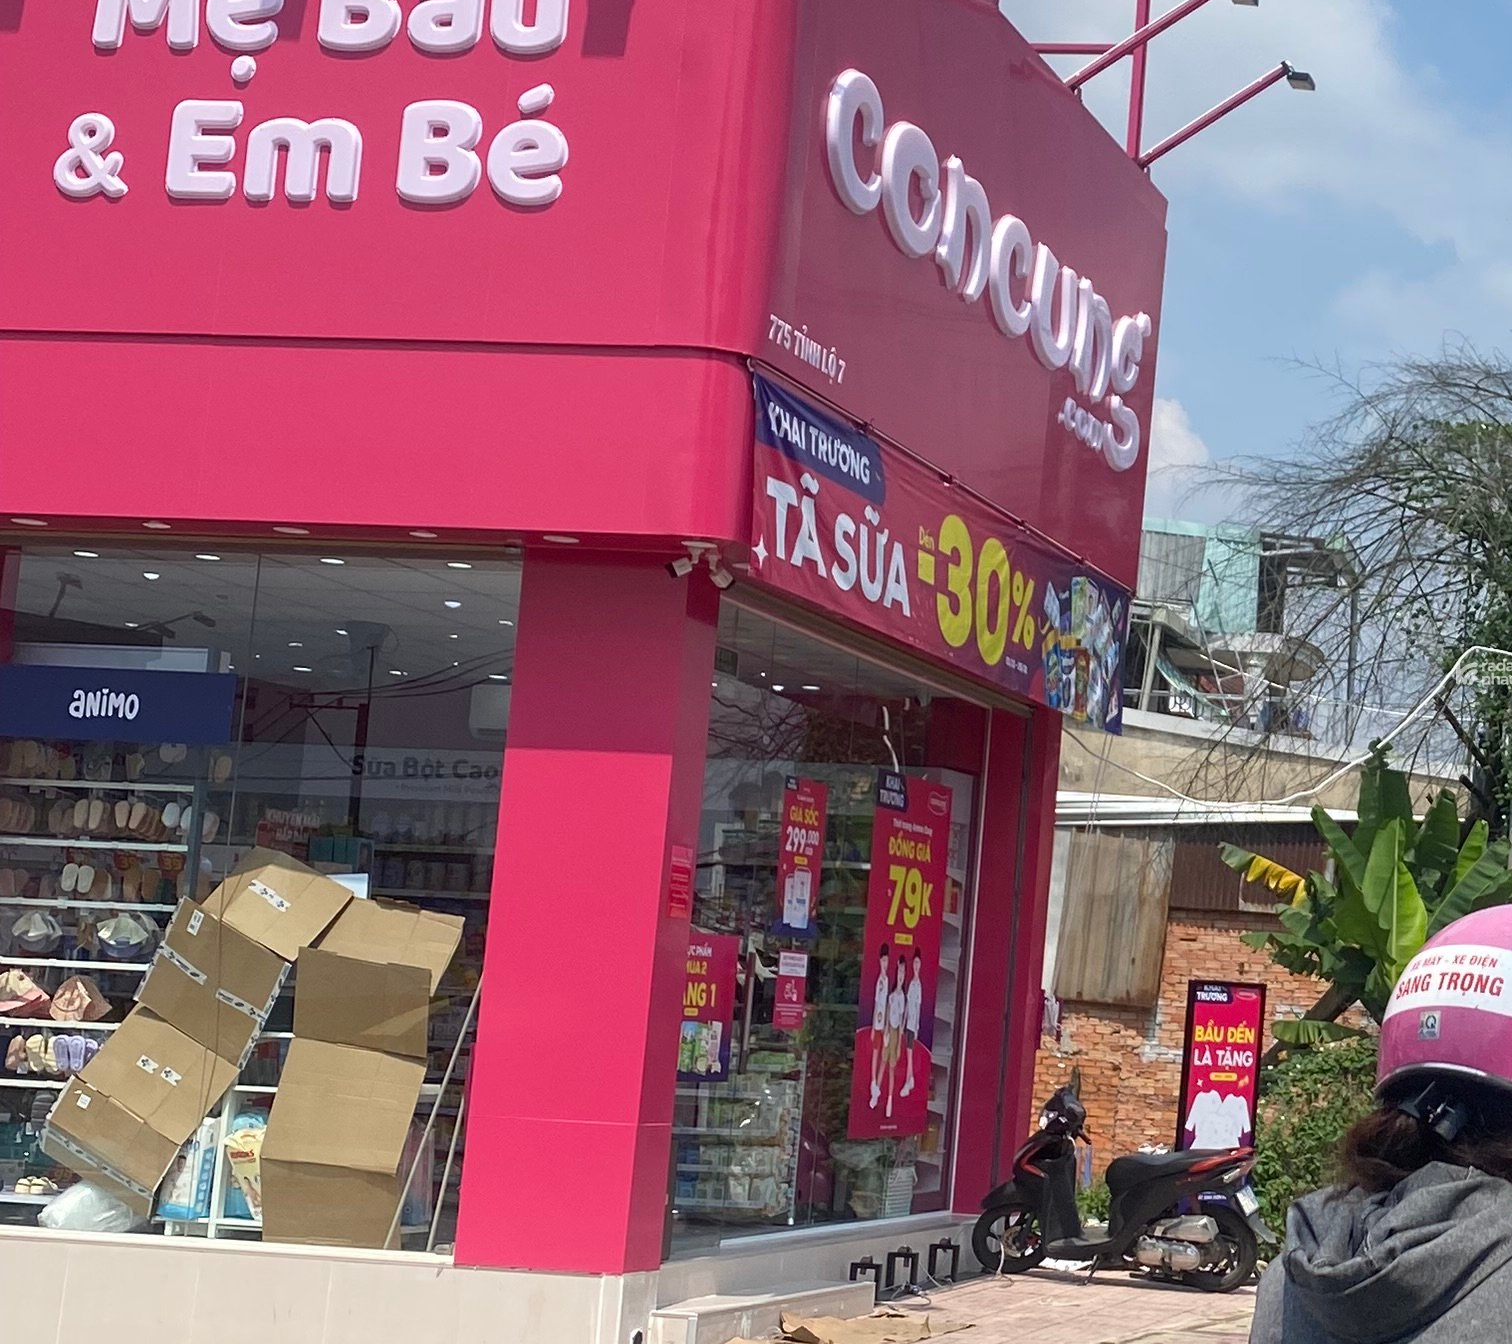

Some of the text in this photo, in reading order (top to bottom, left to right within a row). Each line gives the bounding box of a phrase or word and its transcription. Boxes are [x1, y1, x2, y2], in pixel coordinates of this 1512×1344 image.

[53, 83, 570, 205] & Em Bé
[768, 313, 847, 385] 775 TỈNH LỘ 7
[768, 401, 871, 485] KHAI TRƯƠNG
[766, 472, 912, 618] TÃ SỮA
[917, 514, 1036, 666] -30%
[402, 756, 446, 782] Bột
[452, 759, 499, 780] Cao
[916, 838, 932, 864] GIÁ
[1452, 954, 1467, 965] XE
[1469, 954, 1499, 969] ĐIỆN
[710, 984, 717, 1007] 1
[1196, 990, 1228, 1003] TRƯƠNG
[1437, 971, 1505, 997] TRỌNG
[1194, 1018, 1255, 1044] BẦU ĐẾN
[1193, 1044, 1254, 1071] LÀ TẶNG
